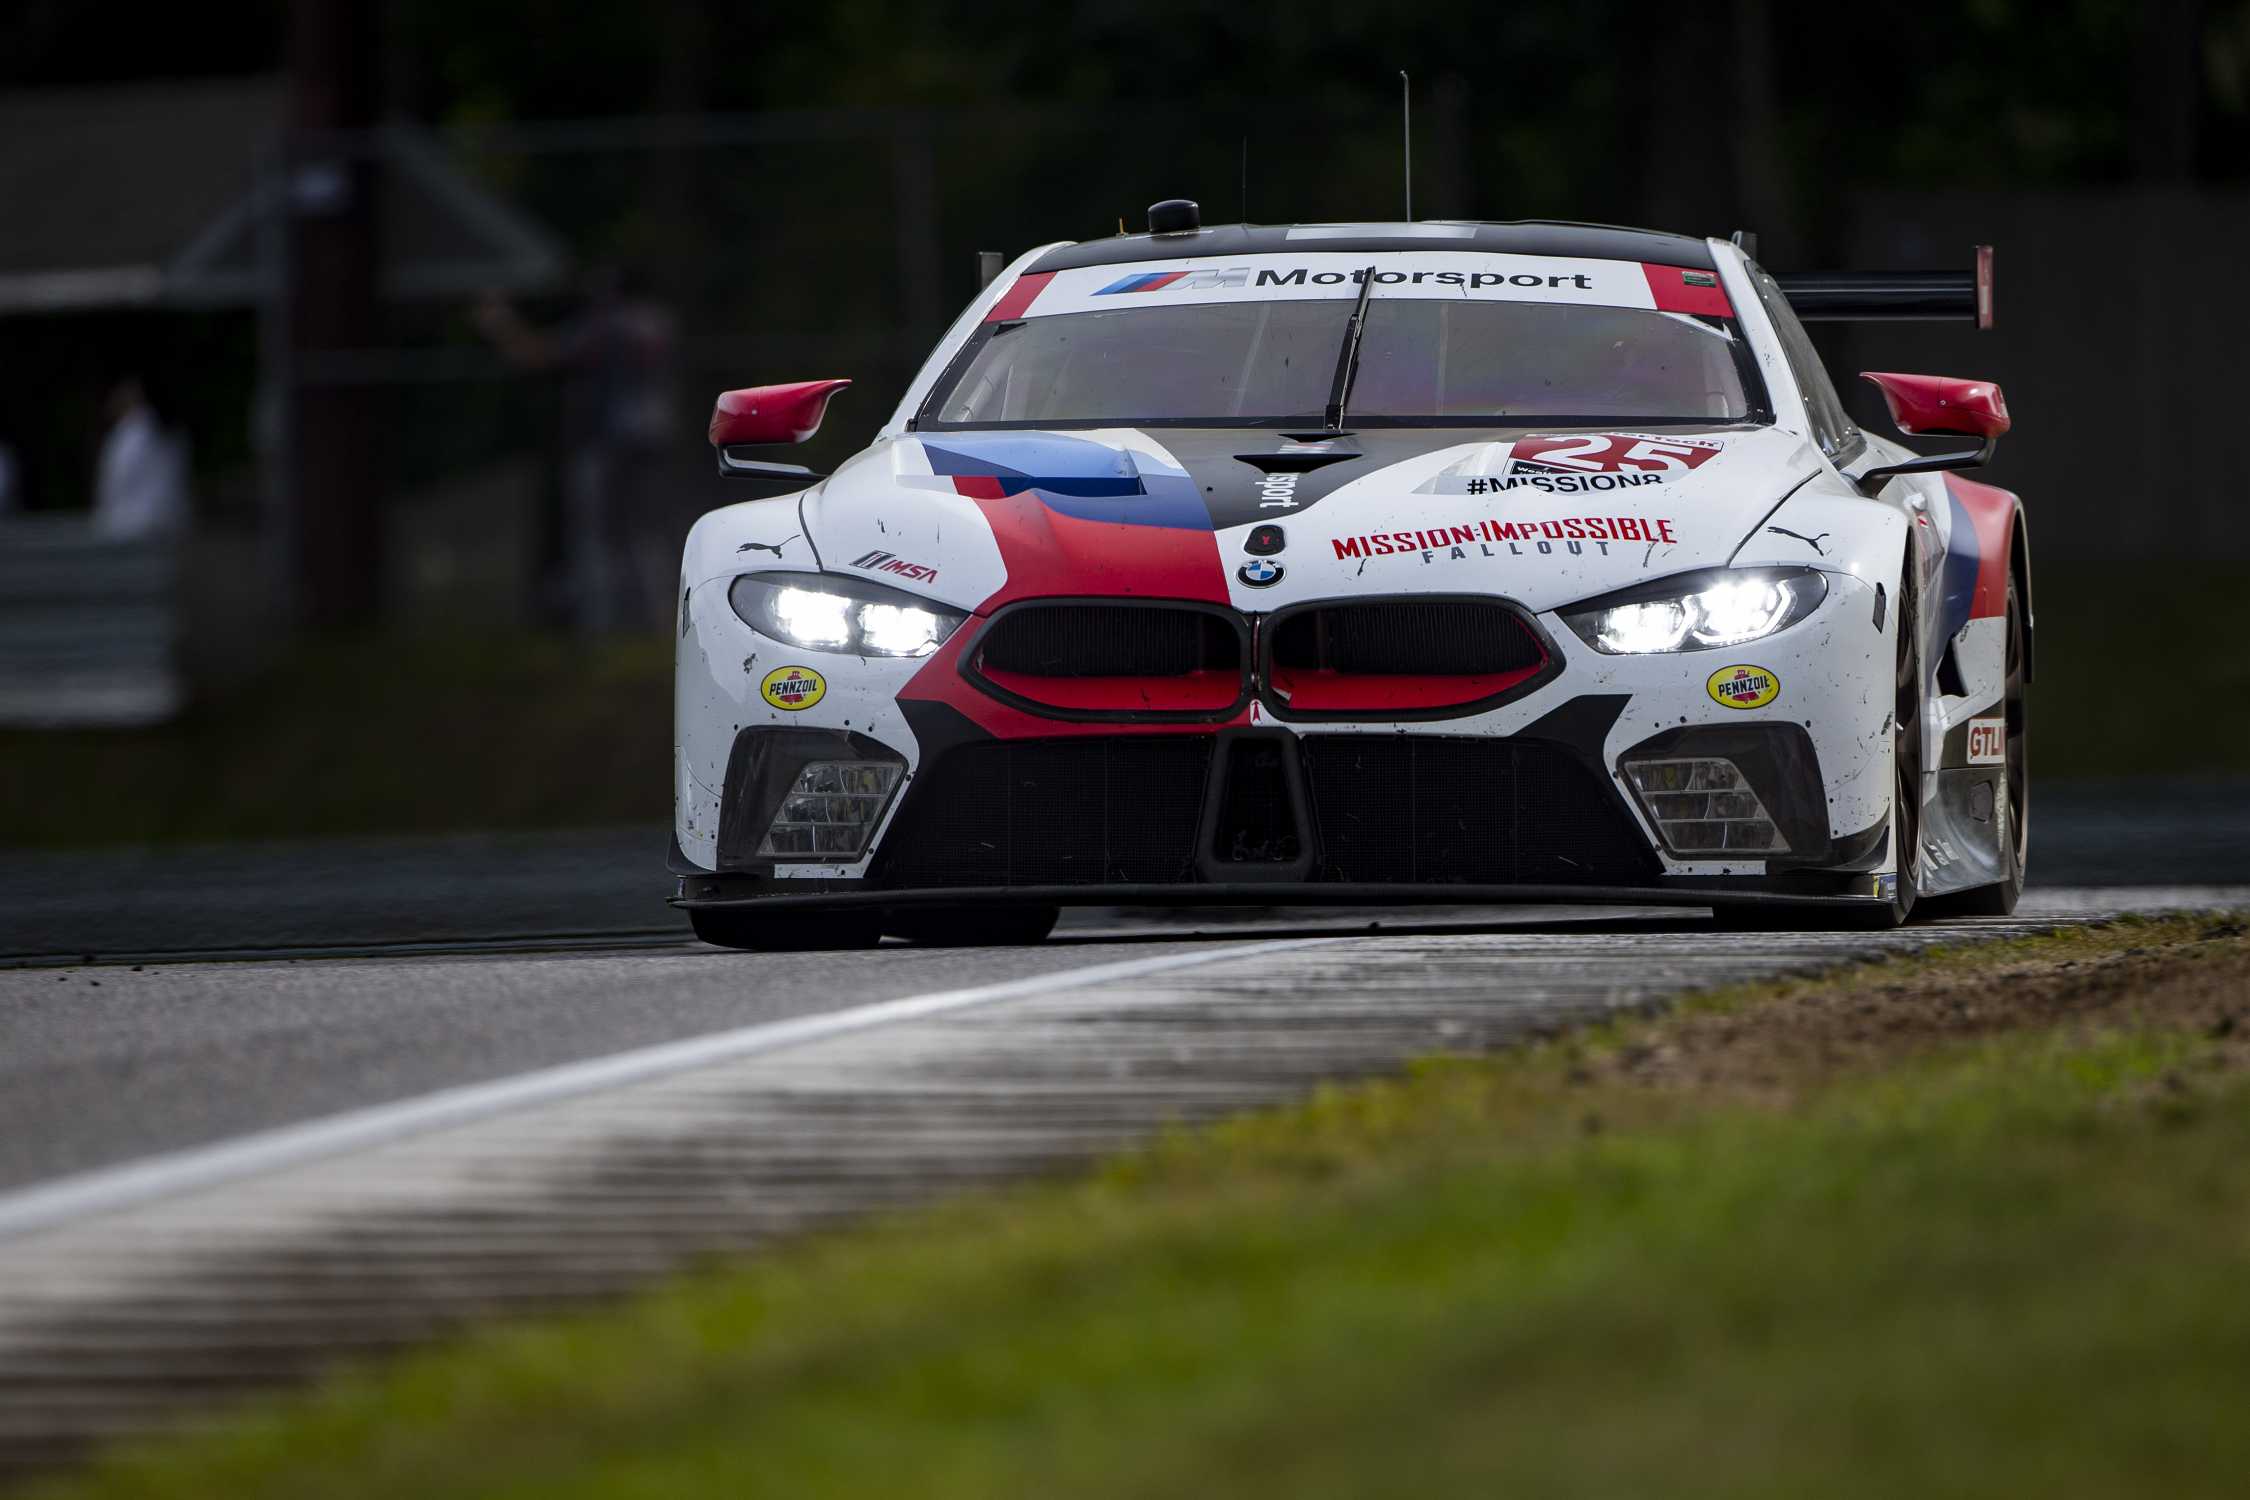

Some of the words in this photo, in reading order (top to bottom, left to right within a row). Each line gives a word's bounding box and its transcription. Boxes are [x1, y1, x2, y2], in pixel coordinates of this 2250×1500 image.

[1256, 269, 1592, 289] Motorsport
[1532, 436, 1690, 471] 25
[1467, 474, 1662, 495] #MISSION8
[1422, 541, 1609, 563] FALLOUT
[878, 559, 937, 584] IMSA
[769, 679, 817, 696] PENNZOIL
[1718, 675, 1770, 697] PENNZOIL
